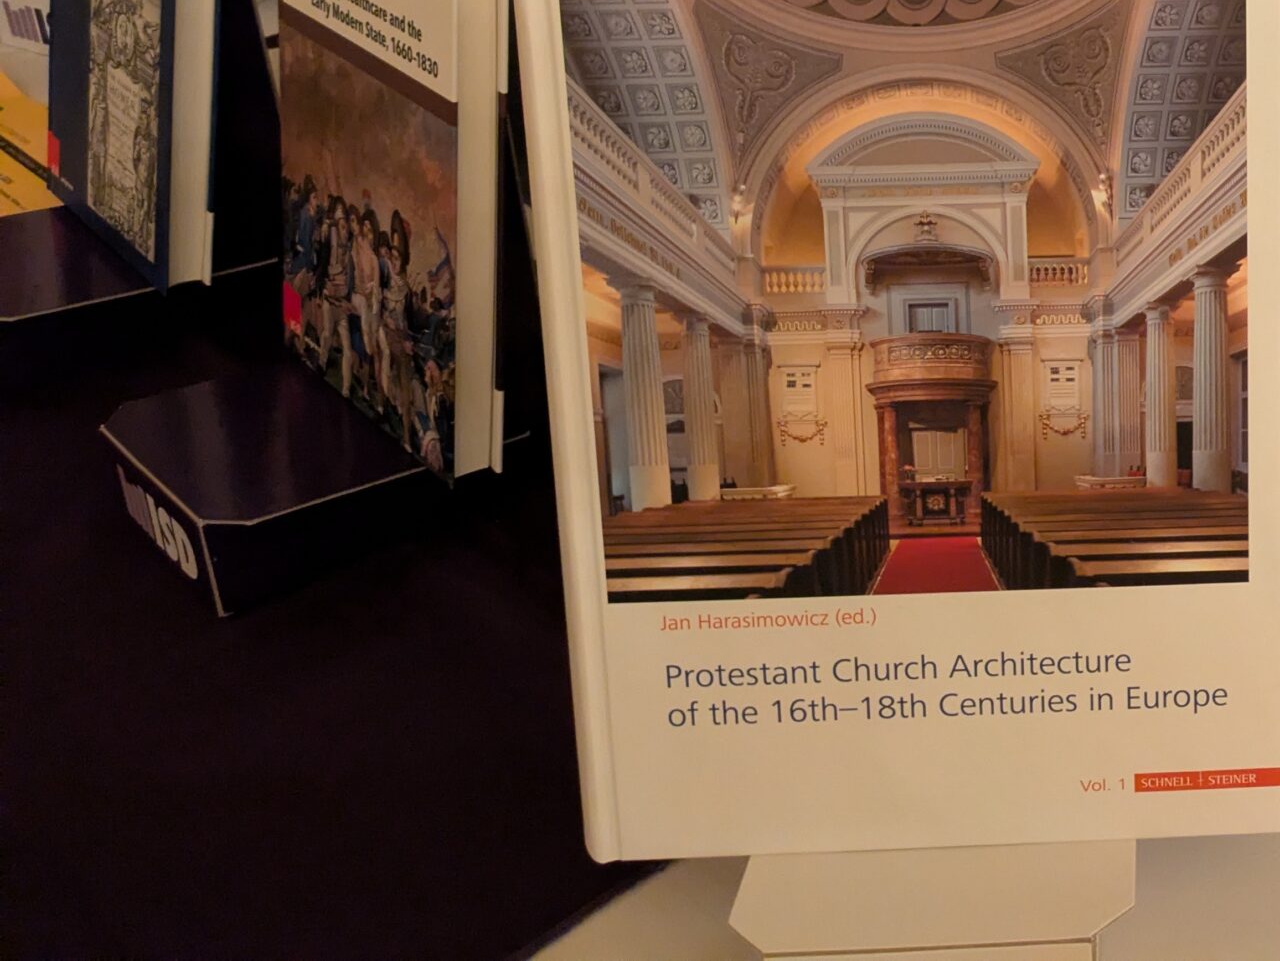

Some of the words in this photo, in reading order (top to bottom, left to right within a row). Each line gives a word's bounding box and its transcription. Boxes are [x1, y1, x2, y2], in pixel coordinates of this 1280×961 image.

[332, 2, 364, 35] Modern
[365, 22, 390, 52] State,
[390, 37, 439, 79] 1660-1830
[389, 9, 406, 33] and
[408, 19, 422, 43] the
[660, 614, 691, 631] Jan
[698, 609, 830, 631] Harasimowicz
[836, 607, 877, 628] (ed.)
[666, 659, 821, 689] Protestant
[832, 654, 939, 683] Church
[949, 648, 1132, 680] Architecture
[667, 698, 699, 729] of
[708, 697, 759, 726] the
[939, 687, 1078, 719] Centuries
[1089, 685, 1114, 711] in
[1127, 684, 1229, 716] Europe
[1080, 777, 1112, 793] Vol.
[1118, 777, 1126, 792] 1
[1141, 776, 1194, 789] SCHNELL
[1207, 772, 1257, 787] STEINER
